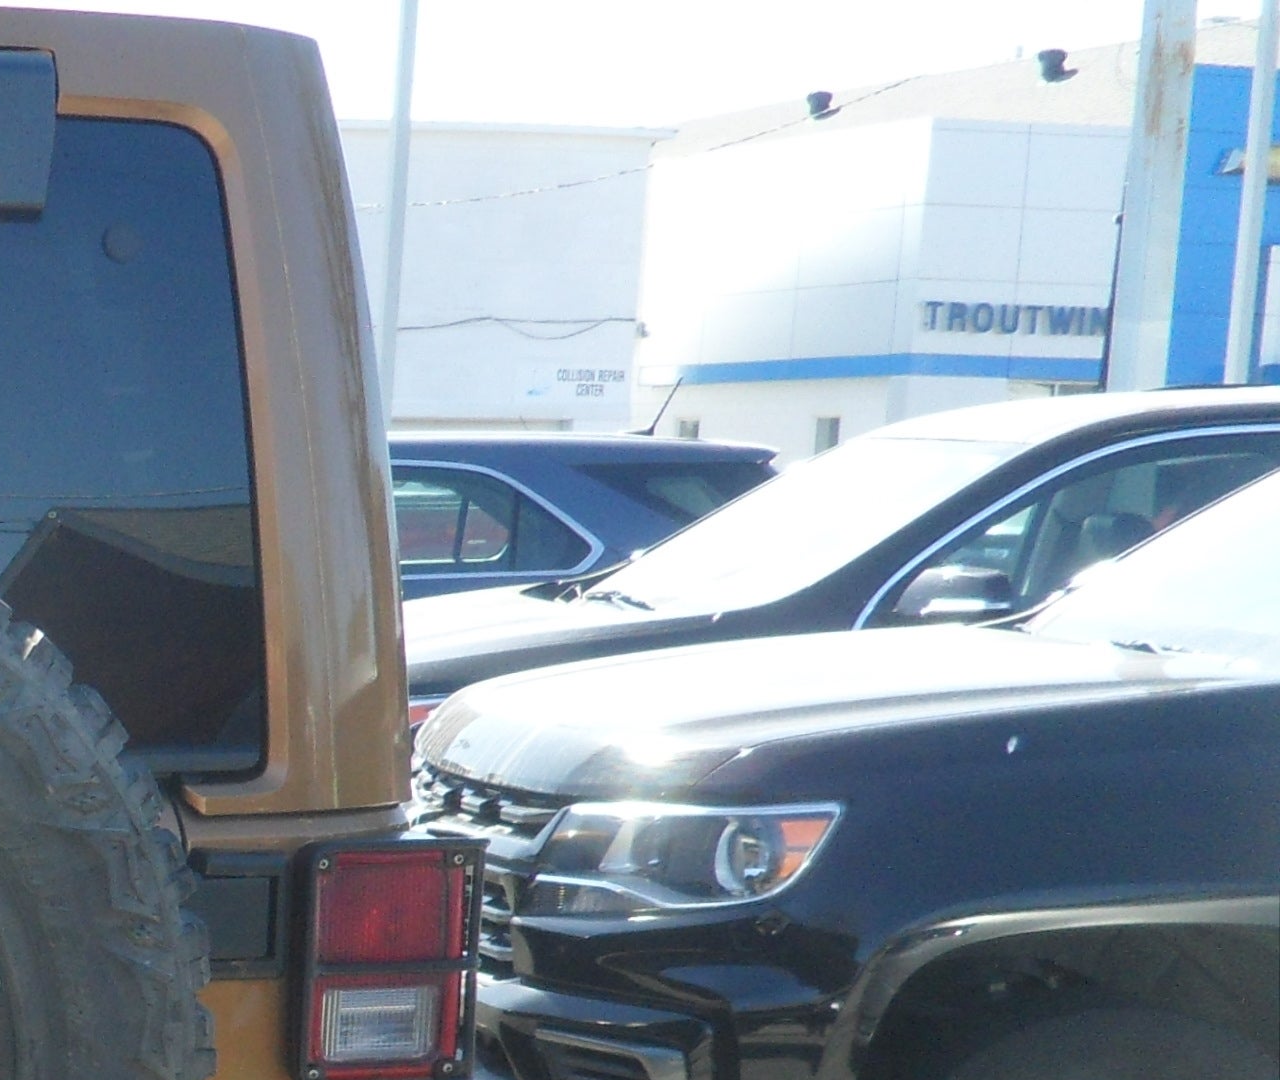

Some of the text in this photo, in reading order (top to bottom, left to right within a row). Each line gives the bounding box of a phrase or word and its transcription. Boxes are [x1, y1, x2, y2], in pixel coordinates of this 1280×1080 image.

[557, 369, 624, 382] COLLISION REPAIR
[576, 384, 603, 396] CENTER
